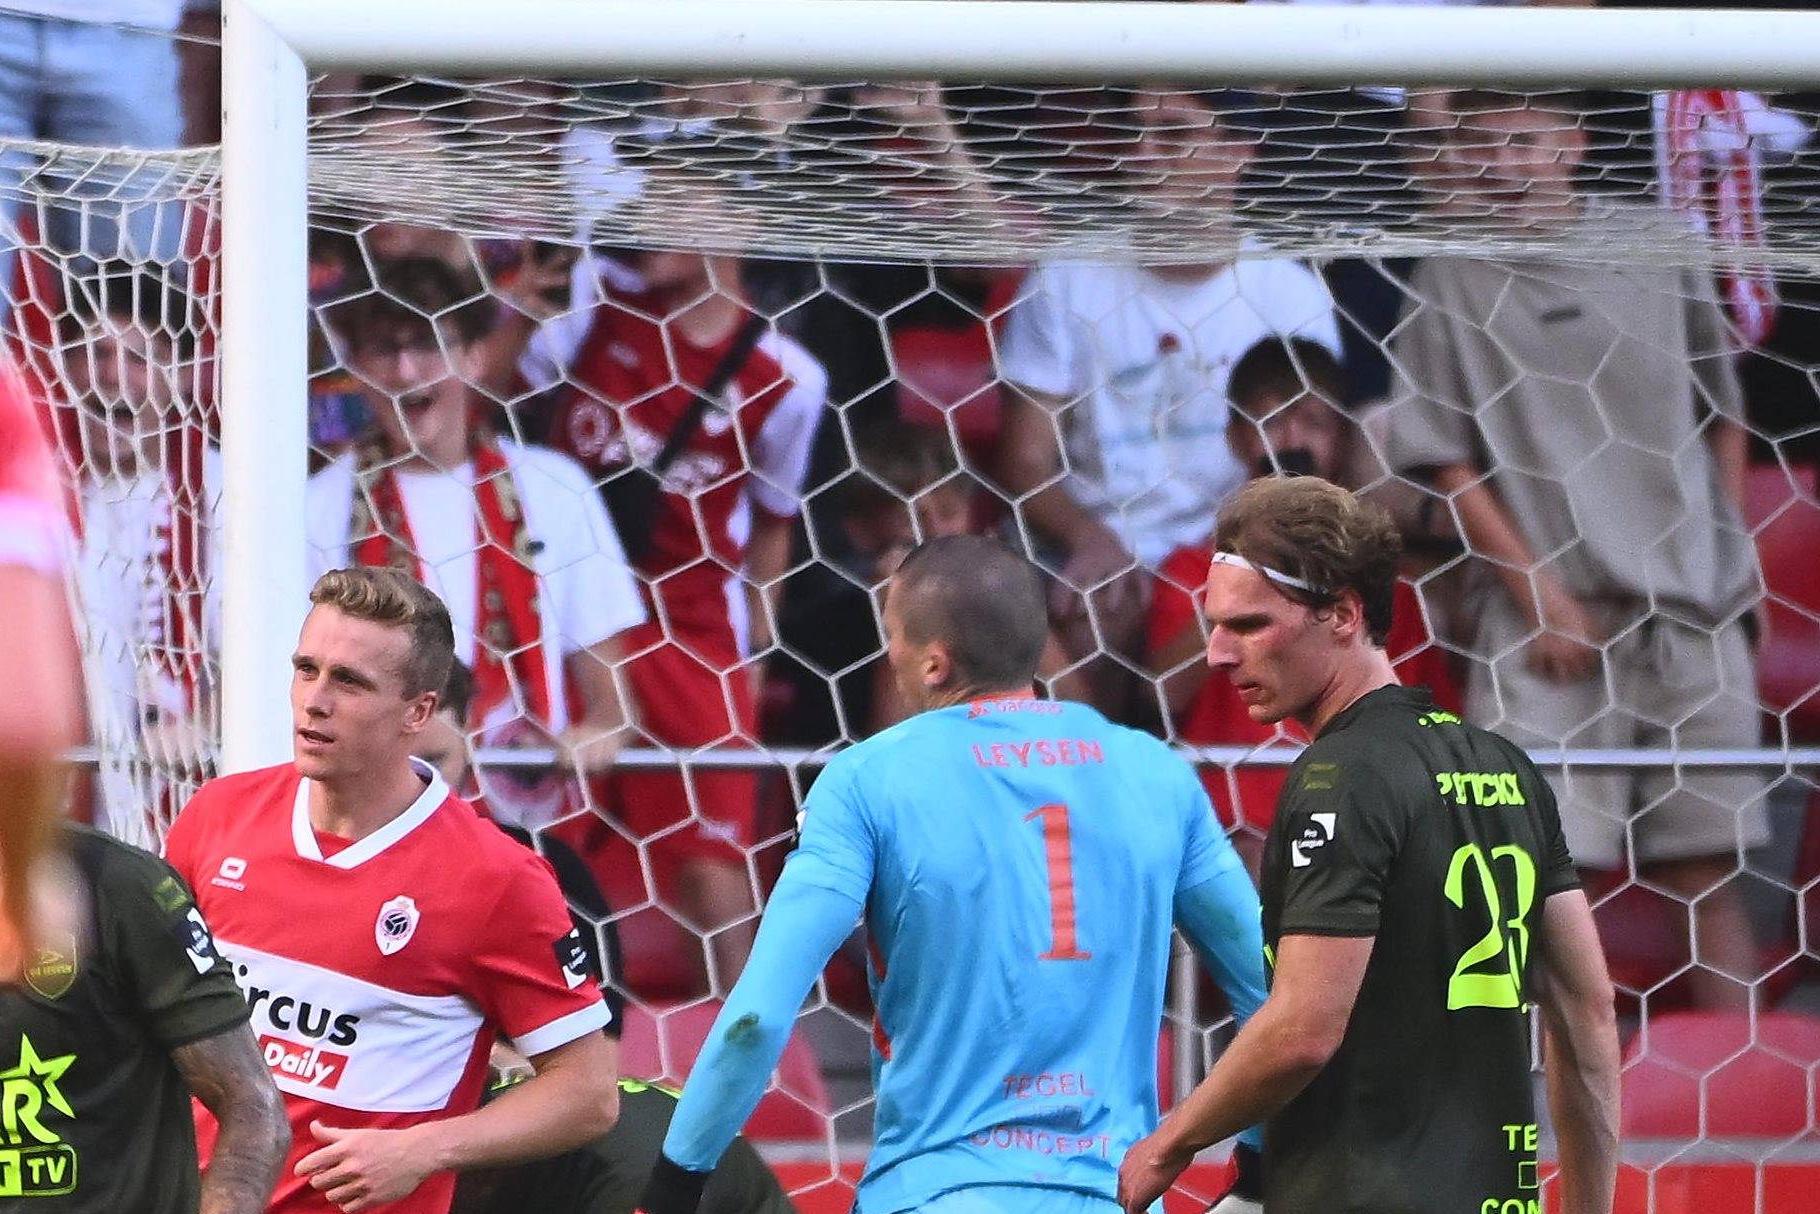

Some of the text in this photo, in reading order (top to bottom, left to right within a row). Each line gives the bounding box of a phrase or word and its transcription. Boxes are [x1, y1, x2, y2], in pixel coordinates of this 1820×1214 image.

[972, 738, 1105, 768] LEYSEN
[1023, 804, 1092, 961] 1
[238, 964, 360, 1046] rcus
[263, 1041, 335, 1087] Daily
[1002, 1071, 1095, 1100] TEGEL
[26, 1156, 67, 1185] TV
